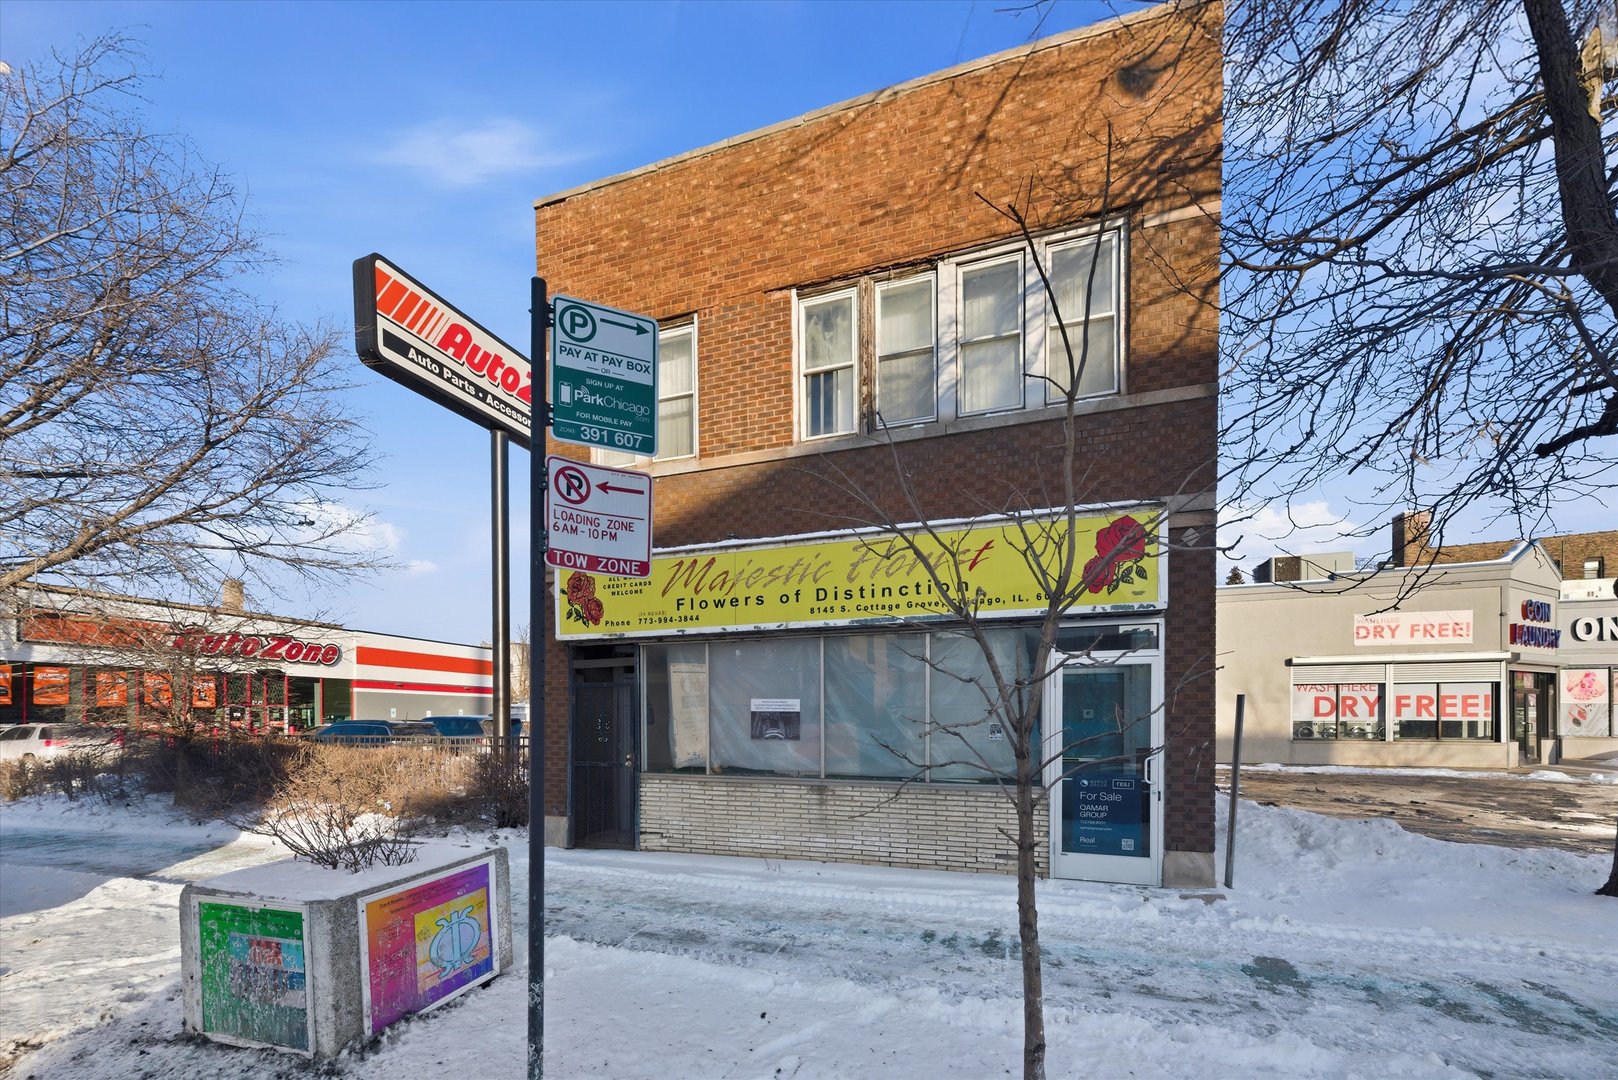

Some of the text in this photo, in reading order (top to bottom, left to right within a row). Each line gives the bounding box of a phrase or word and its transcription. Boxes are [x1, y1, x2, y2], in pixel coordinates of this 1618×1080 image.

[560, 345, 651, 375] PAY AT PAY BOX
[408, 348, 440, 374] Auto
[443, 369, 476, 395] Parts
[586, 378, 603, 387] SIGN
[615, 384, 624, 392] AT
[574, 389, 650, 416] ParkChicago
[576, 411, 633, 427] FOR MOBILE PAY
[581, 426, 608, 443] 391
[615, 433, 642, 449] 607
[553, 509, 635, 532] LOADING ZONE
[553, 550, 641, 574] TOW ZONE
[603, 582, 627, 590] CREDIT
[662, 552, 834, 598] Majestic
[677, 594, 764, 611] Flowers
[780, 589, 801, 604] of
[810, 606, 835, 614] 8145
[840, 605, 850, 613] S.
[856, 603, 900, 612] Cottage
[1012, 594, 1029, 602] IL.
[1524, 599, 1551, 623] COIN
[638, 614, 700, 626] 773-994-3844
[1355, 622, 1471, 640] DRY FREE!
[1514, 623, 1562, 649] LAUNDRY
[1296, 684, 1377, 693] WASH HERE
[1313, 694, 1491, 718] DRY FREE!
[1080, 791, 1122, 802] For Sale
[1080, 836, 1096, 844] Real
